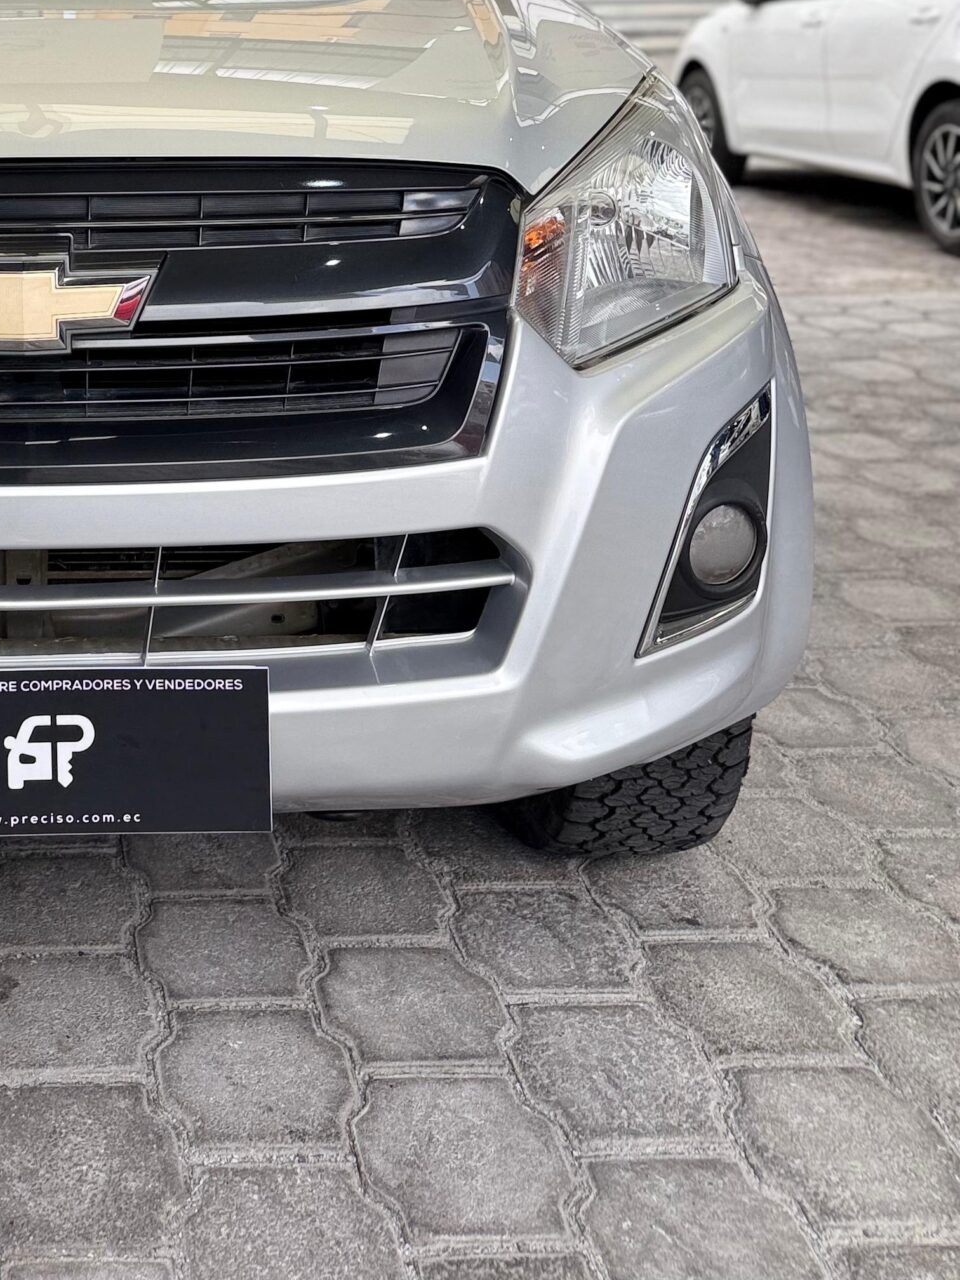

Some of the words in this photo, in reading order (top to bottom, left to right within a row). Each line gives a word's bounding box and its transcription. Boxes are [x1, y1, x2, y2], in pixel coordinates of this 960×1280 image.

[20, 678, 132, 693] COMPRADORES
[133, 678, 144, 691] Y
[145, 678, 244, 691] VENDEDORES
